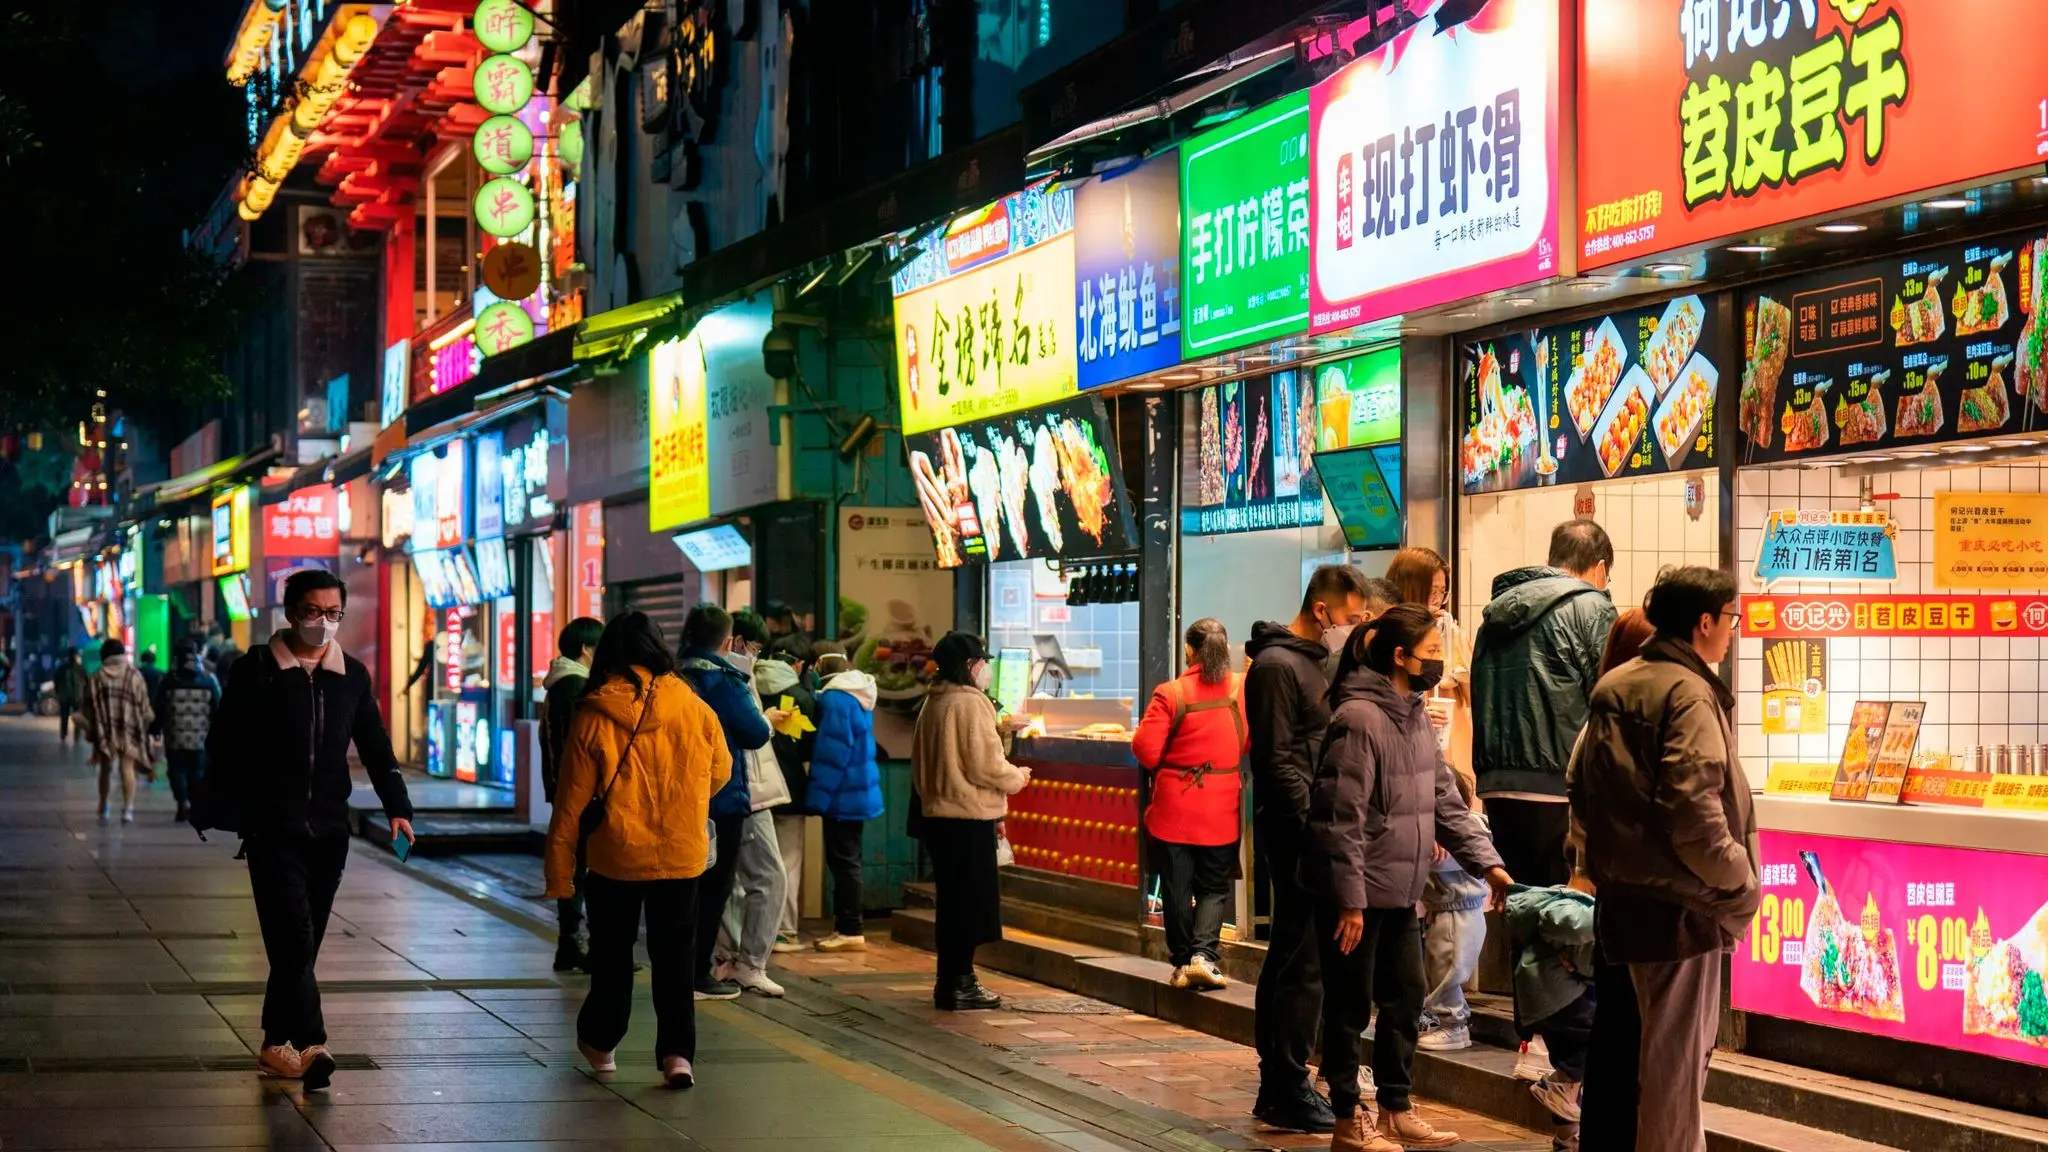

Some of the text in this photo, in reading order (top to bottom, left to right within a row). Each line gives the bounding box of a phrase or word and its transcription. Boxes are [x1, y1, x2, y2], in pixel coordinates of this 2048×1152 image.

[1681, 16, 1905, 203] 苕皮豆干
[1363, 88, 1521, 239] 现打虾滑
[1192, 177, 1309, 284] 手打柠檬茶
[1079, 260, 1181, 362] 北海鱿鱼王
[1800, 304, 1816, 322] 口味
[1776, 527, 1883, 548] 大众点评小吃快餐
[1959, 539, 2043, 552] 重庆必吃小吃
[1771, 546, 1880, 573] 热门榜第1名
[1786, 607, 1846, 625] 何记兴
[1876, 606, 1971, 627] 苕皮豆干
[1760, 863, 1797, 886] 卤猪耳朵
[1971, 929, 1990, 948] 新品
